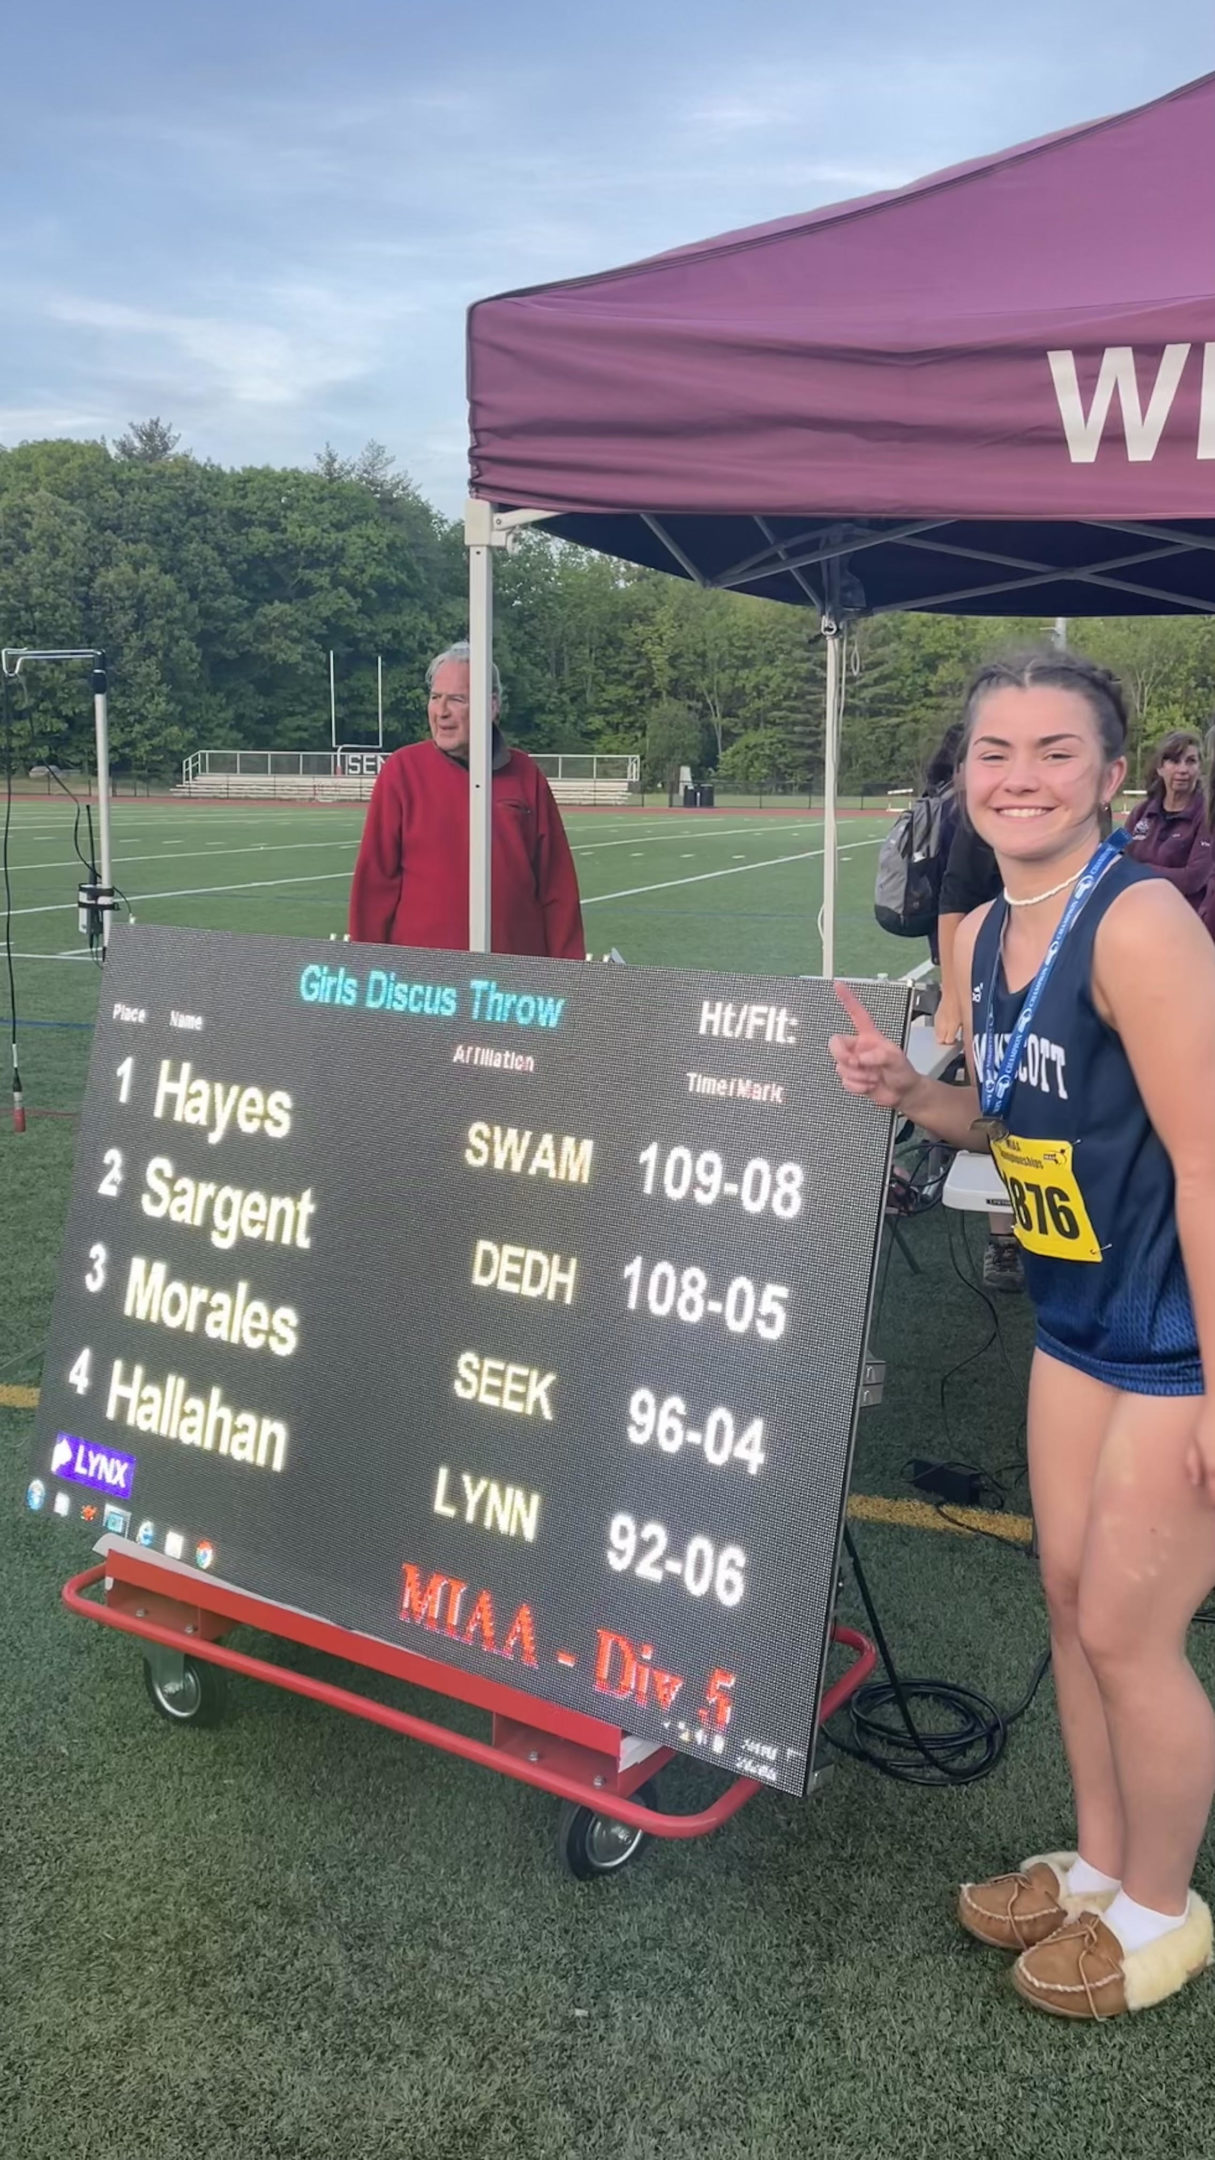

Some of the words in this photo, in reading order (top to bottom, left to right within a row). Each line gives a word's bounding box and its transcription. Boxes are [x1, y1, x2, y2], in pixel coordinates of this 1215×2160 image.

[112, 1003, 147, 1023] Place
[169, 1010, 203, 1031] Name
[300, 964, 357, 1006] Girls
[366, 970, 457, 1018] Discus
[470, 979, 566, 1029] Throw
[453, 1044, 535, 1072] Affiliation
[686, 1073, 785, 1104] Time/Mark
[116, 1057, 133, 1104] 1
[153, 1059, 293, 1145] Hayes
[464, 1121, 595, 1184] SWAM
[637, 1141, 804, 1219] 109-08
[97, 1148, 123, 1197] 2
[141, 1156, 317, 1250] Sargent
[85, 1242, 107, 1293] 3
[124, 1256, 299, 1356] Morales
[471, 1239, 577, 1305] DEDH
[622, 1255, 791, 1340] 108-05
[68, 1347, 91, 1395] 4
[105, 1359, 288, 1473] Hallahan
[453, 1352, 558, 1421] SEEK
[74, 1444, 129, 1489] LYNX
[626, 1387, 766, 1476] 96-04
[433, 1466, 540, 1543] LYNN
[605, 1512, 748, 1607] 92-06
[399, 1561, 539, 1670] MIAA
[591, 1627, 685, 1713] Div
[697, 1665, 737, 1732] 5
